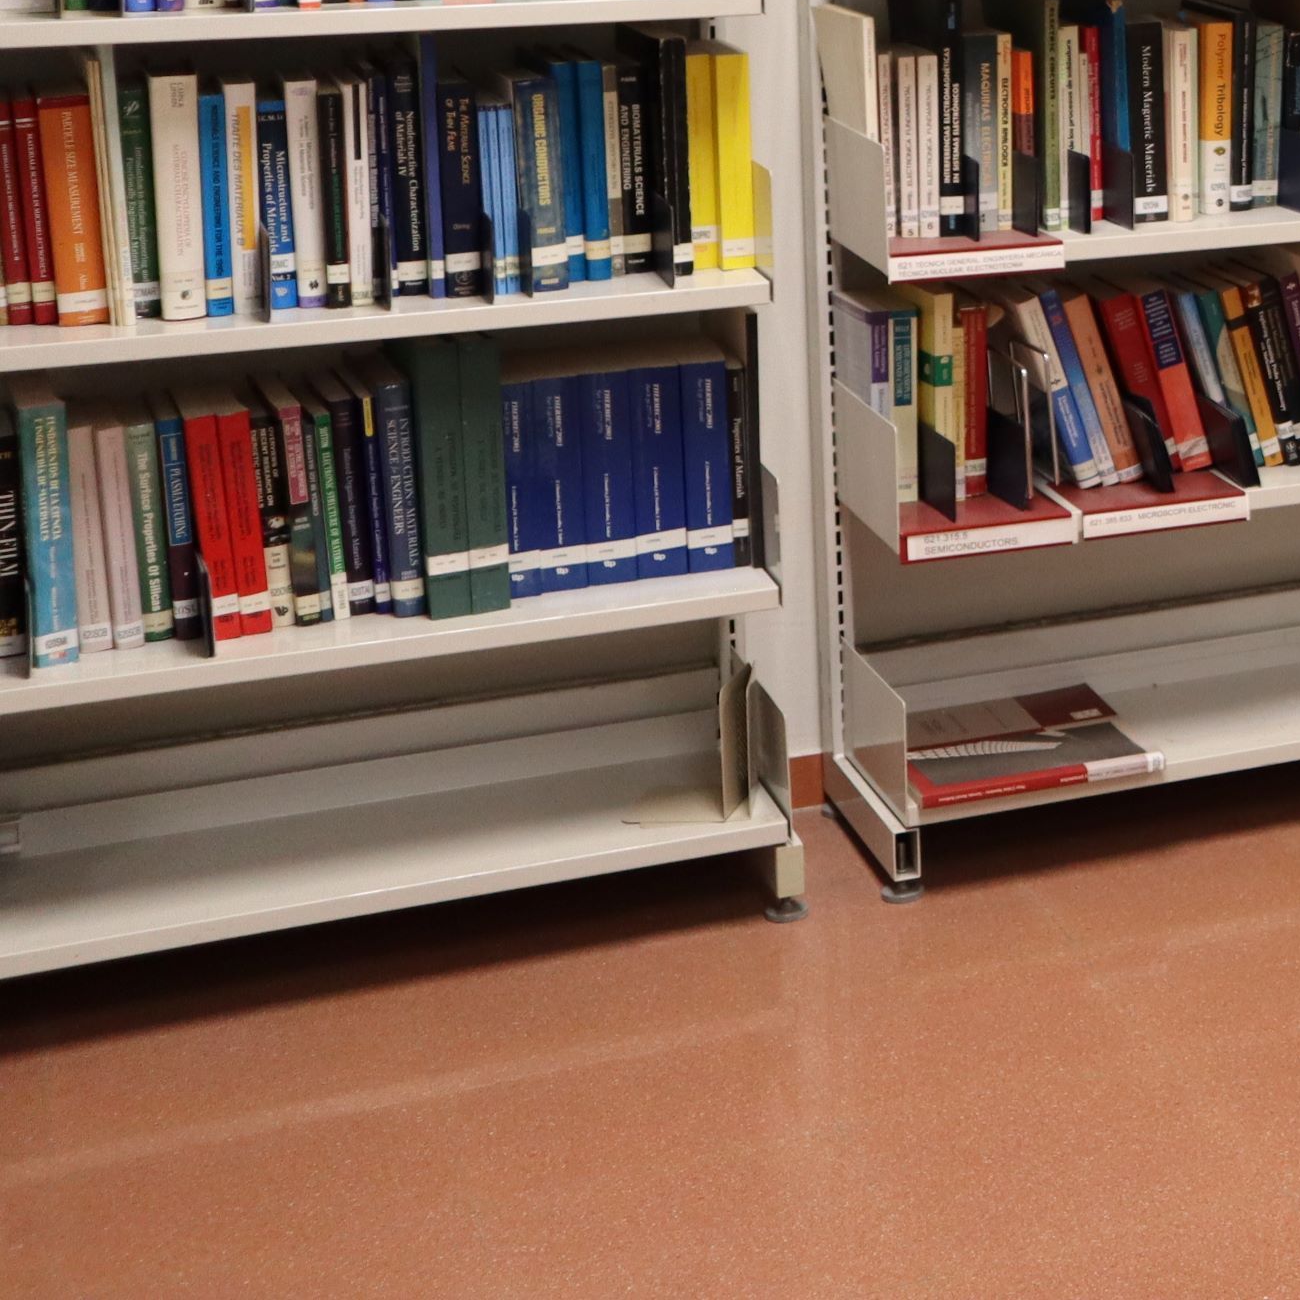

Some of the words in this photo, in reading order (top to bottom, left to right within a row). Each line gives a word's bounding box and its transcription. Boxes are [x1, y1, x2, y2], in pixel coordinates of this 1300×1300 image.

[1140, 45, 1153, 88] Modern
[620, 104, 630, 126] AND
[1141, 90, 1154, 140] Magnetic
[631, 104, 643, 173] BIOMATERIALS
[260, 142, 275, 189] Properties
[621, 128, 632, 190] ENGINEERING
[1143, 141, 1157, 193] Materials
[266, 189, 274, 200] of
[275, 150, 289, 220] Microstructure
[634, 176, 646, 216] SCIENCE
[266, 200, 280, 253] Materials
[280, 221, 291, 243] and
[136, 452, 148, 473] The
[139, 474, 152, 510] Surface
[1137, 508, 1187, 521] MICROSCOPI
[143, 510, 158, 562] Properties
[924, 536, 1019, 556] SEMICONDUCTORS
[150, 564, 160, 579] Of
[151, 580, 162, 611] Silicas
